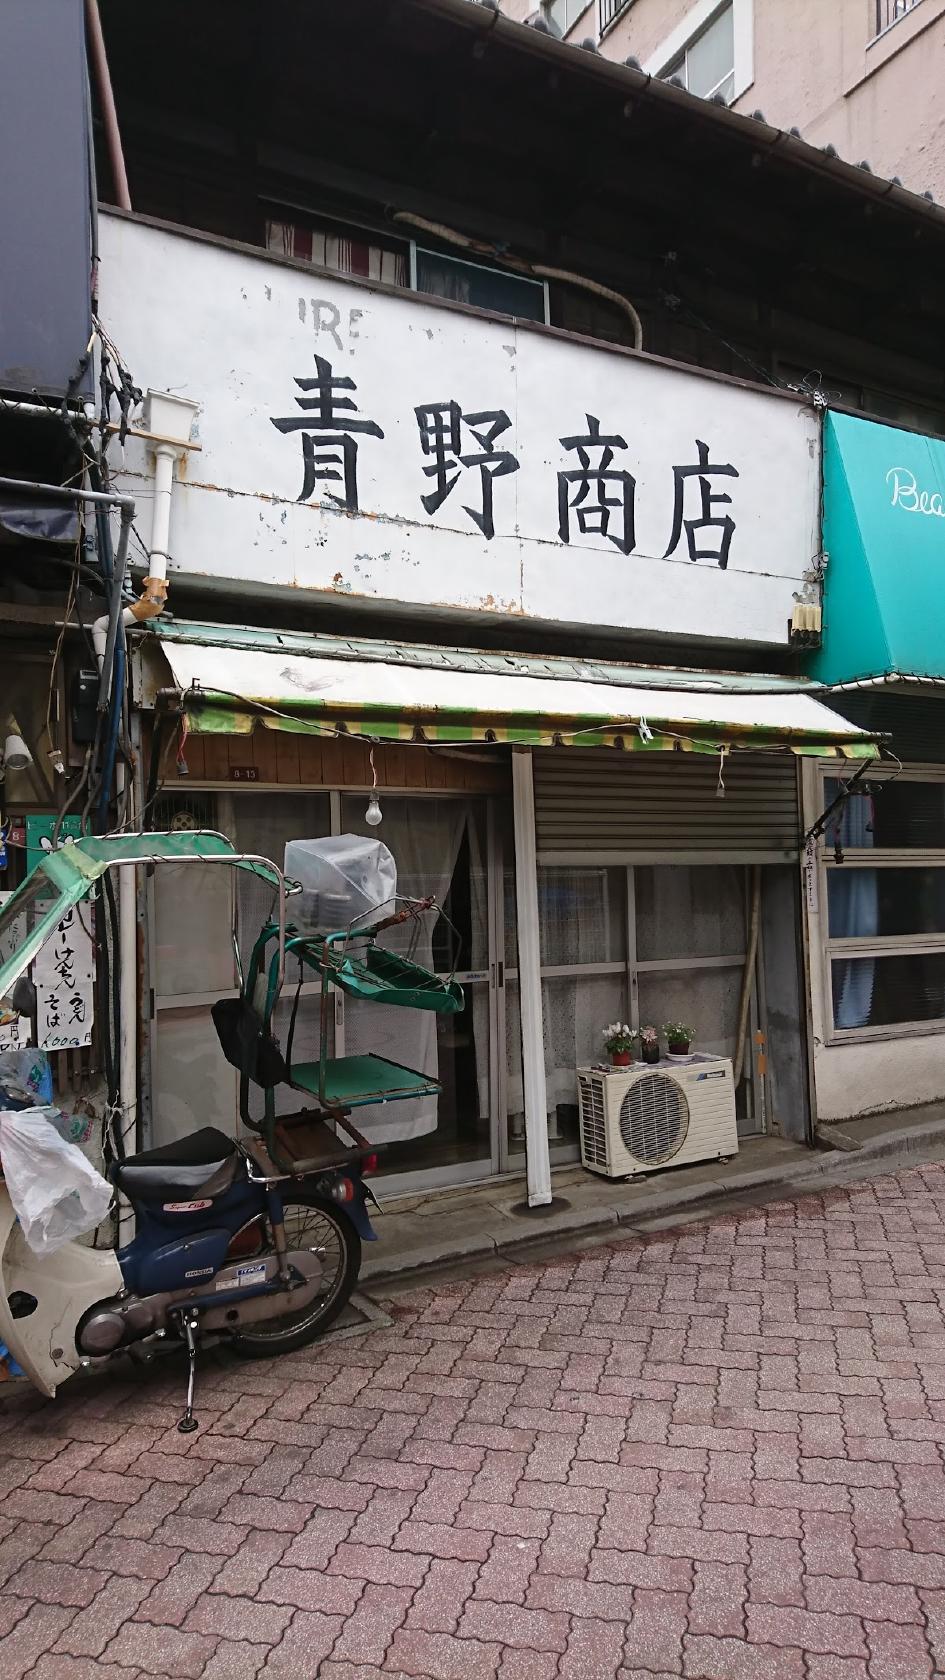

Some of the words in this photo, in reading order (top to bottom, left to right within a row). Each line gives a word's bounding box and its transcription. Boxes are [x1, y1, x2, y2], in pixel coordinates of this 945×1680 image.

[269, 353, 740, 571] 青野商店
[44, 994, 66, 1028] そば
